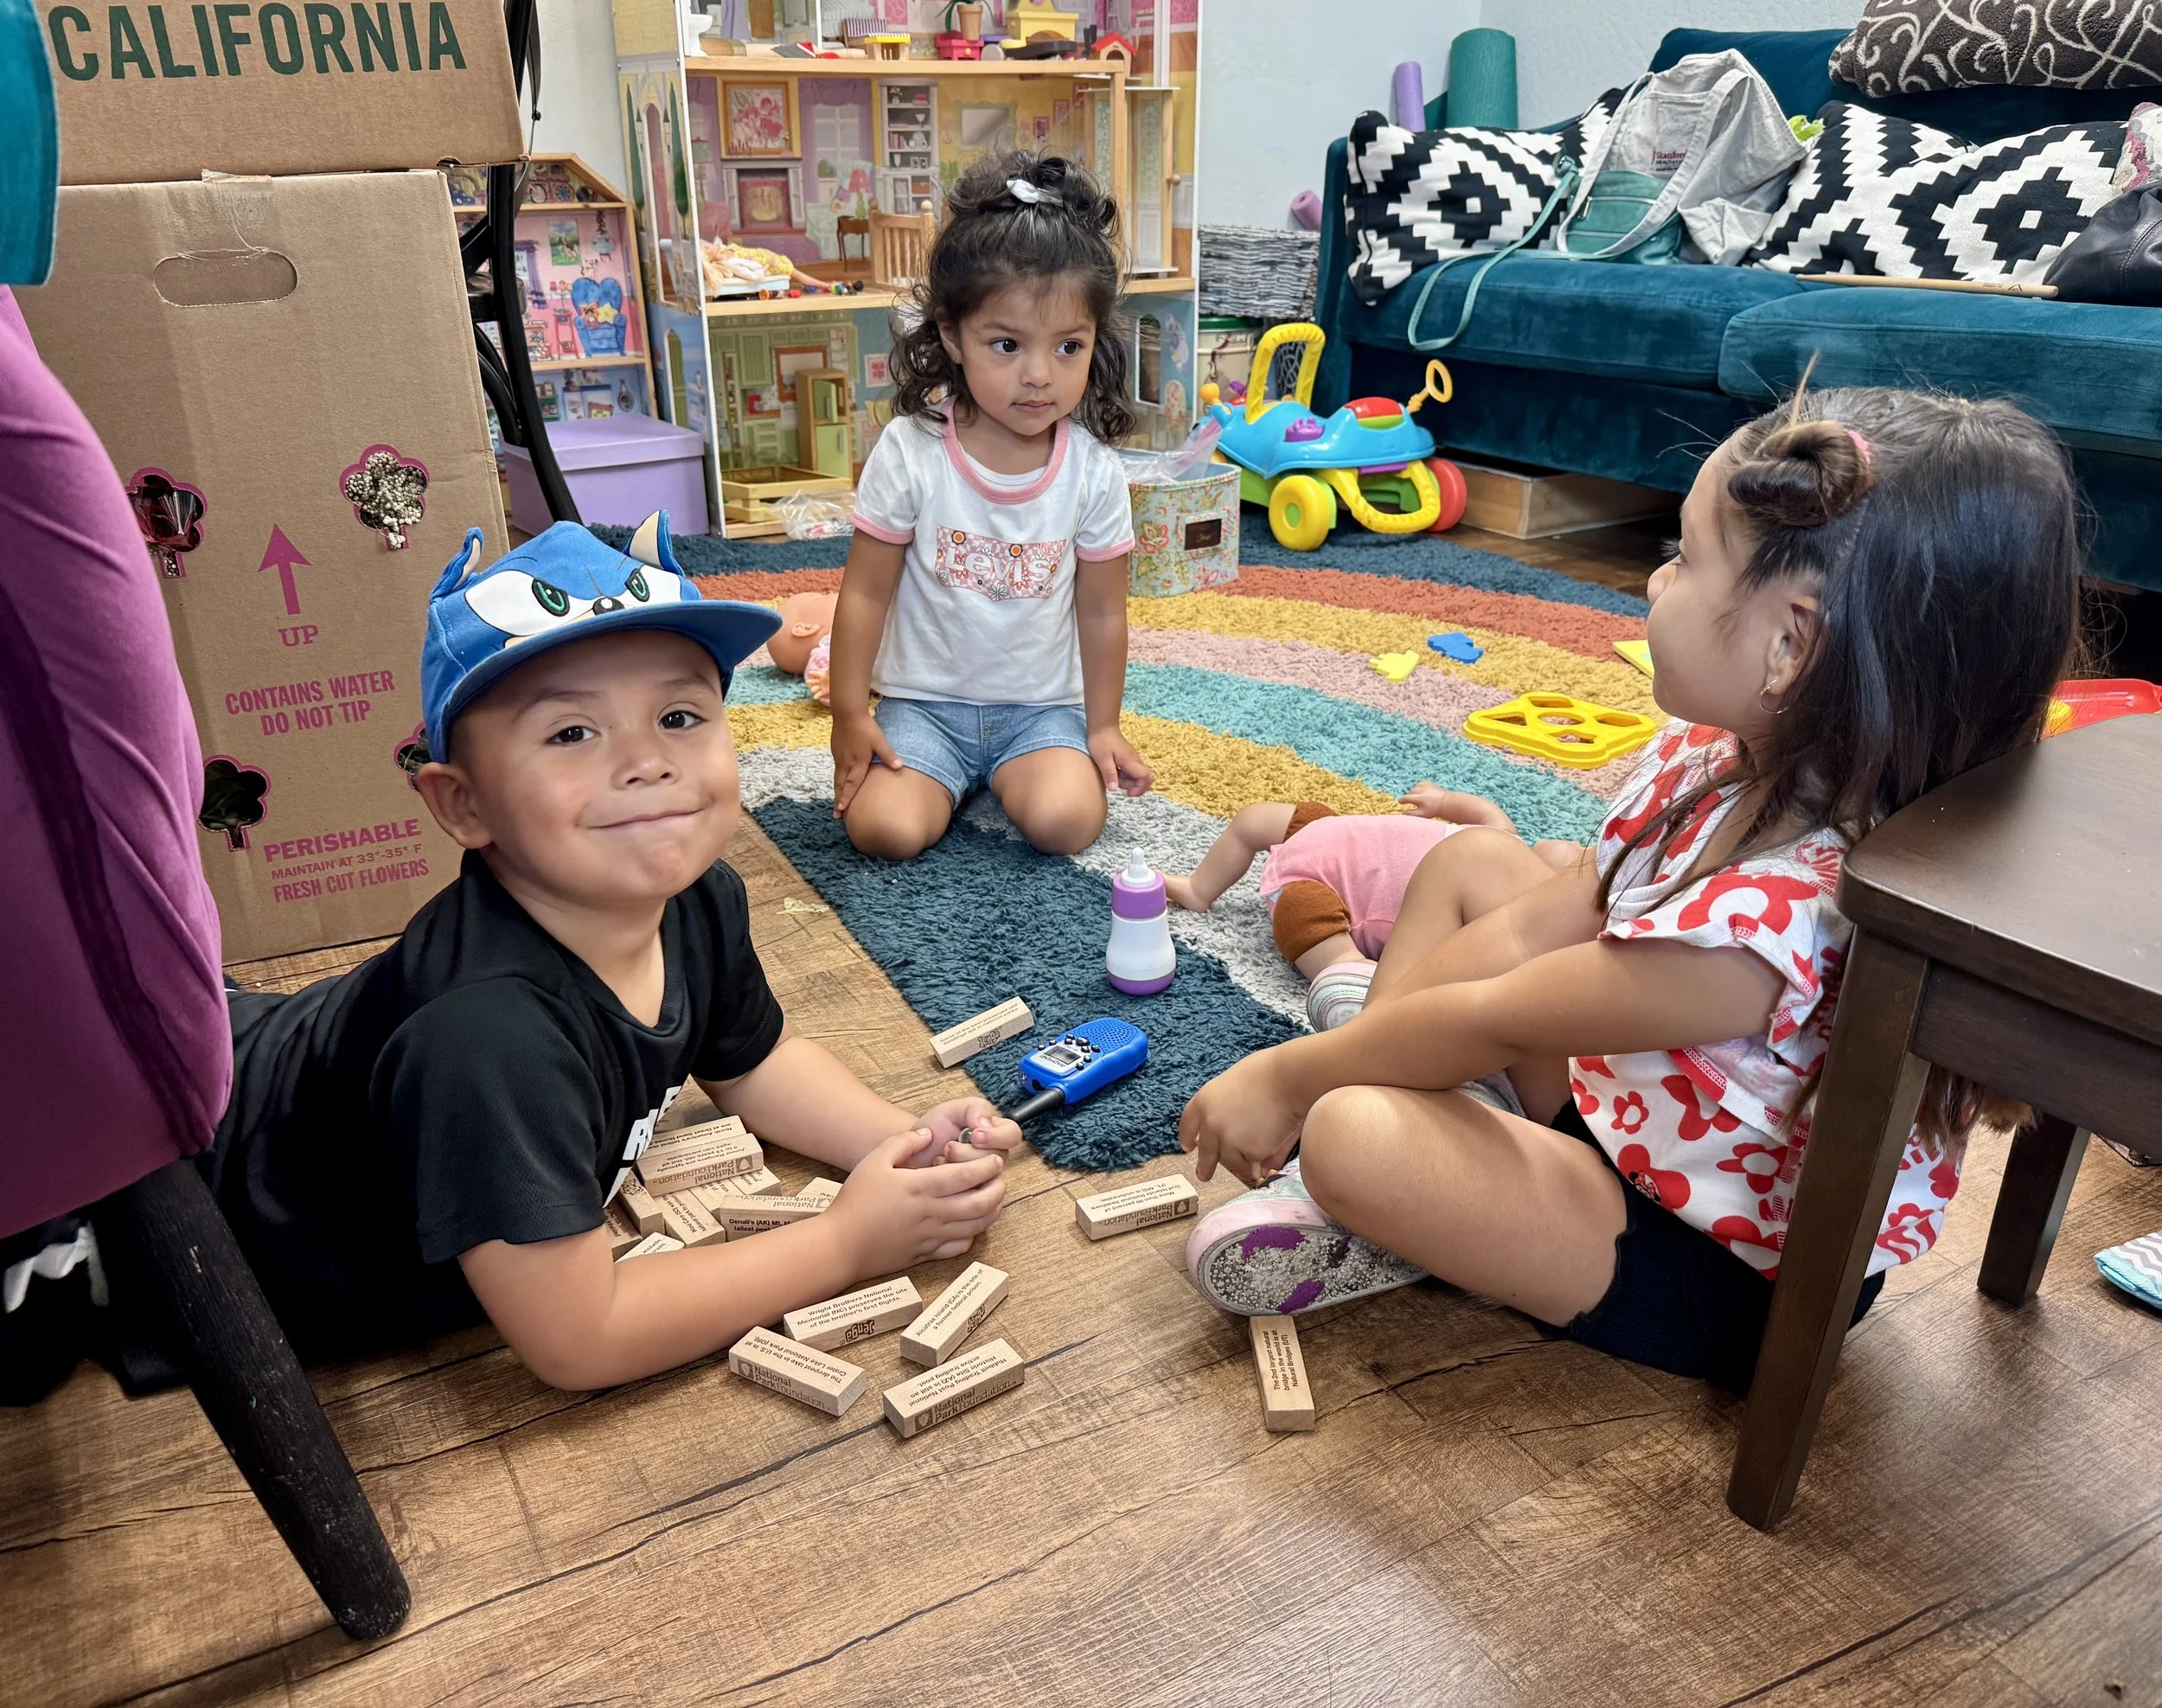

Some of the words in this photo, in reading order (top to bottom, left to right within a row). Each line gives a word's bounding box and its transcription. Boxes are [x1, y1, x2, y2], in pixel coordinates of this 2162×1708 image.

[48, 1, 468, 81] CALIFORNIA
[278, 624, 319, 647] UP
[225, 680, 325, 715] CONTAINS
[328, 670, 395, 699] WATER
[261, 713, 290, 736] DO
[296, 704, 334, 731] NOT
[337, 700, 371, 724] TIP
[263, 818, 421, 863] PERISHABLE
[271, 860, 335, 880] MAINTAIN
[338, 855, 354, 867] AT
[357, 845, 409, 864] 33°-35°
[413, 843, 422, 854] F
[272, 877, 323, 903] FRESH
[326, 872, 355, 893] CUT
[359, 859, 430, 888] FLOWERS
[977, 1028, 1001, 1048] Jenga
[694, 1167, 734, 1184] National
[1136, 1209, 1172, 1225] National
[808, 1306, 831, 1315] Wright
[832, 1296, 862, 1308] Brothers
[863, 1286, 892, 1298] National
[831, 1308, 862, 1321] brother's
[878, 1296, 900, 1305] flights.
[916, 1317, 936, 1336] Alcatraz
[933, 1303, 950, 1317] Island
[947, 1294, 959, 1304] (CA)
[969, 1274, 978, 1283] site
[936, 1310, 952, 1326] former
[950, 1295, 968, 1310] federal
[966, 1282, 982, 1295] prison.
[796, 1312, 829, 1325] Memorial
[848, 1296, 881, 1310] preserves
[845, 1320, 875, 1342] Jenga
[1262, 1330, 1271, 1348] natural
[1280, 1334, 1289, 1345] (UT).
[753, 1336, 769, 1345] (OR).
[770, 1342, 784, 1351] Park
[1273, 1341, 1282, 1356] world
[783, 1348, 809, 1361] National
[790, 1359, 804, 1367] lake
[960, 1355, 980, 1366] active
[969, 1355, 996, 1369] Historic
[1266, 1349, 1276, 1367] largest
[1284, 1346, 1294, 1366] Bridges
[803, 1364, 829, 1377] deepest
[809, 1359, 826, 1368] Lake
[826, 1366, 846, 1376] Crater
[981, 1358, 1007, 1372] Hubbell
[754, 1366, 790, 1386] National
[917, 1376, 934, 1386] post.
[935, 1366, 959, 1379] trading
[940, 1374, 956, 1384] (AZ)
[954, 1371, 981, 1384] Trading
[1288, 1366, 1298, 1386] Natural
[920, 1385, 932, 1394] still
[937, 1382, 955, 1392] Post
[909, 1391, 937, 1406] National
[934, 1387, 975, 1412] National
